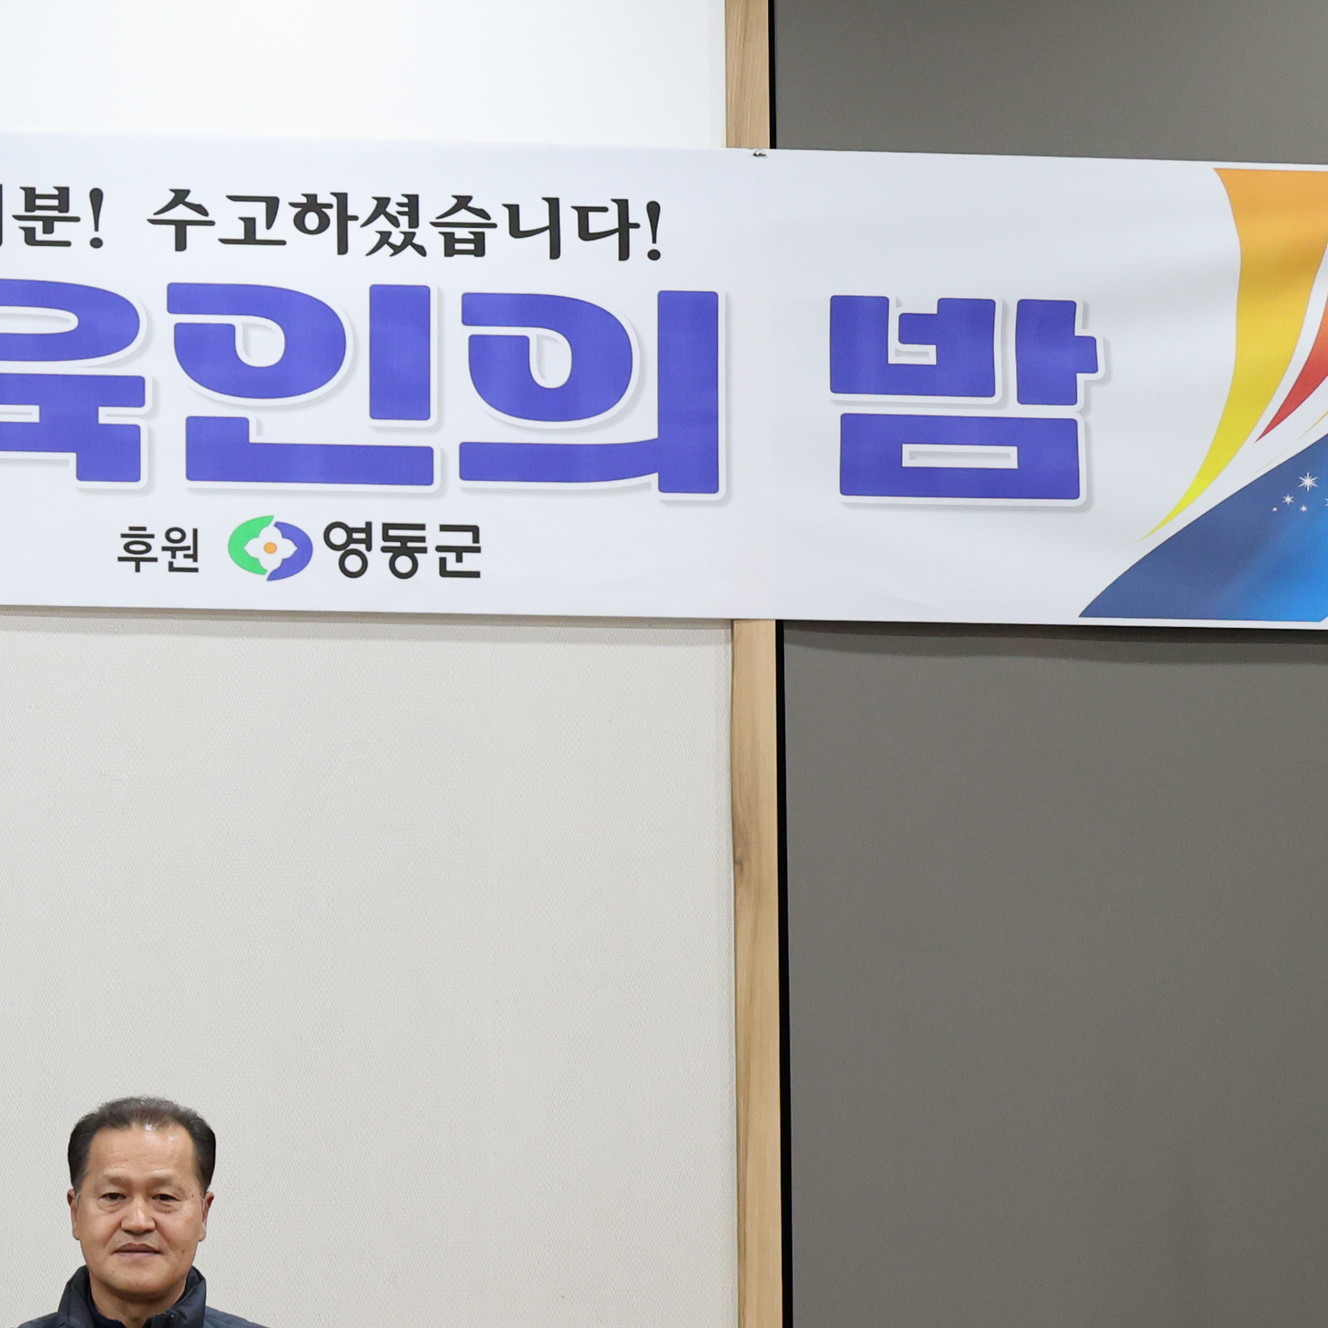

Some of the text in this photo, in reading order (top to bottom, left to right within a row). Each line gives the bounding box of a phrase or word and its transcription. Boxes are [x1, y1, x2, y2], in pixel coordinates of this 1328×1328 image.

[146, 188, 661, 262] 수고하셨습니다!
[830, 295, 1098, 499] 밤
[117, 521, 482, 580] 후원 영동군
